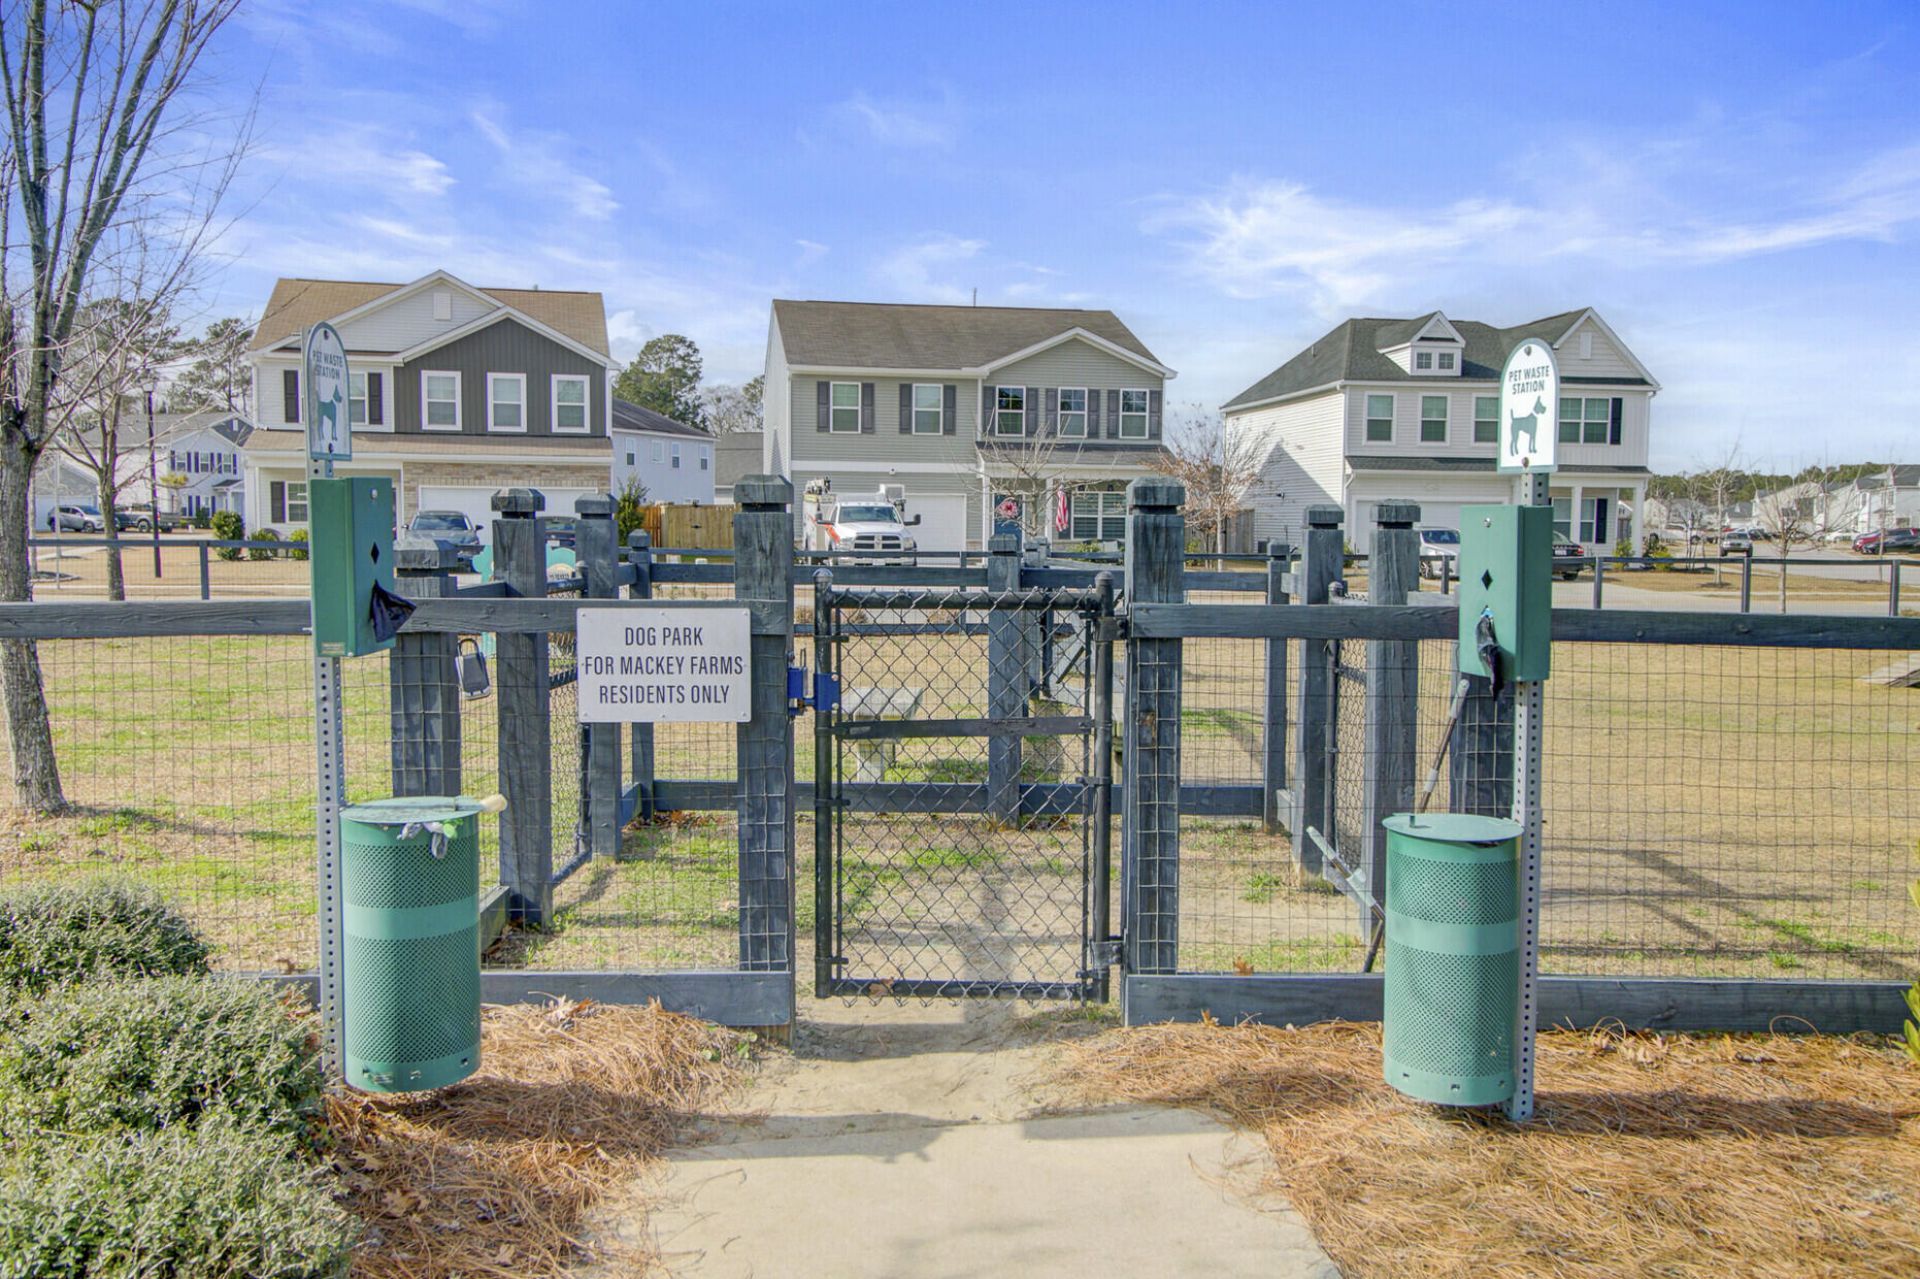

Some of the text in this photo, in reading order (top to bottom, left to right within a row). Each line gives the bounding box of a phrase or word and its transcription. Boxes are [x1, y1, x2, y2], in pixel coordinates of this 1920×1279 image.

[312, 350, 343, 368] PET WASTE
[315, 364, 340, 380] STATION
[1508, 365, 1550, 382] PET WASTE
[1512, 379, 1545, 395] STATION
[625, 627, 704, 646] DOG PARK
[585, 656, 744, 675] FOR MACKEY FARMS
[599, 685, 730, 704] RESIDENTS ONLY
